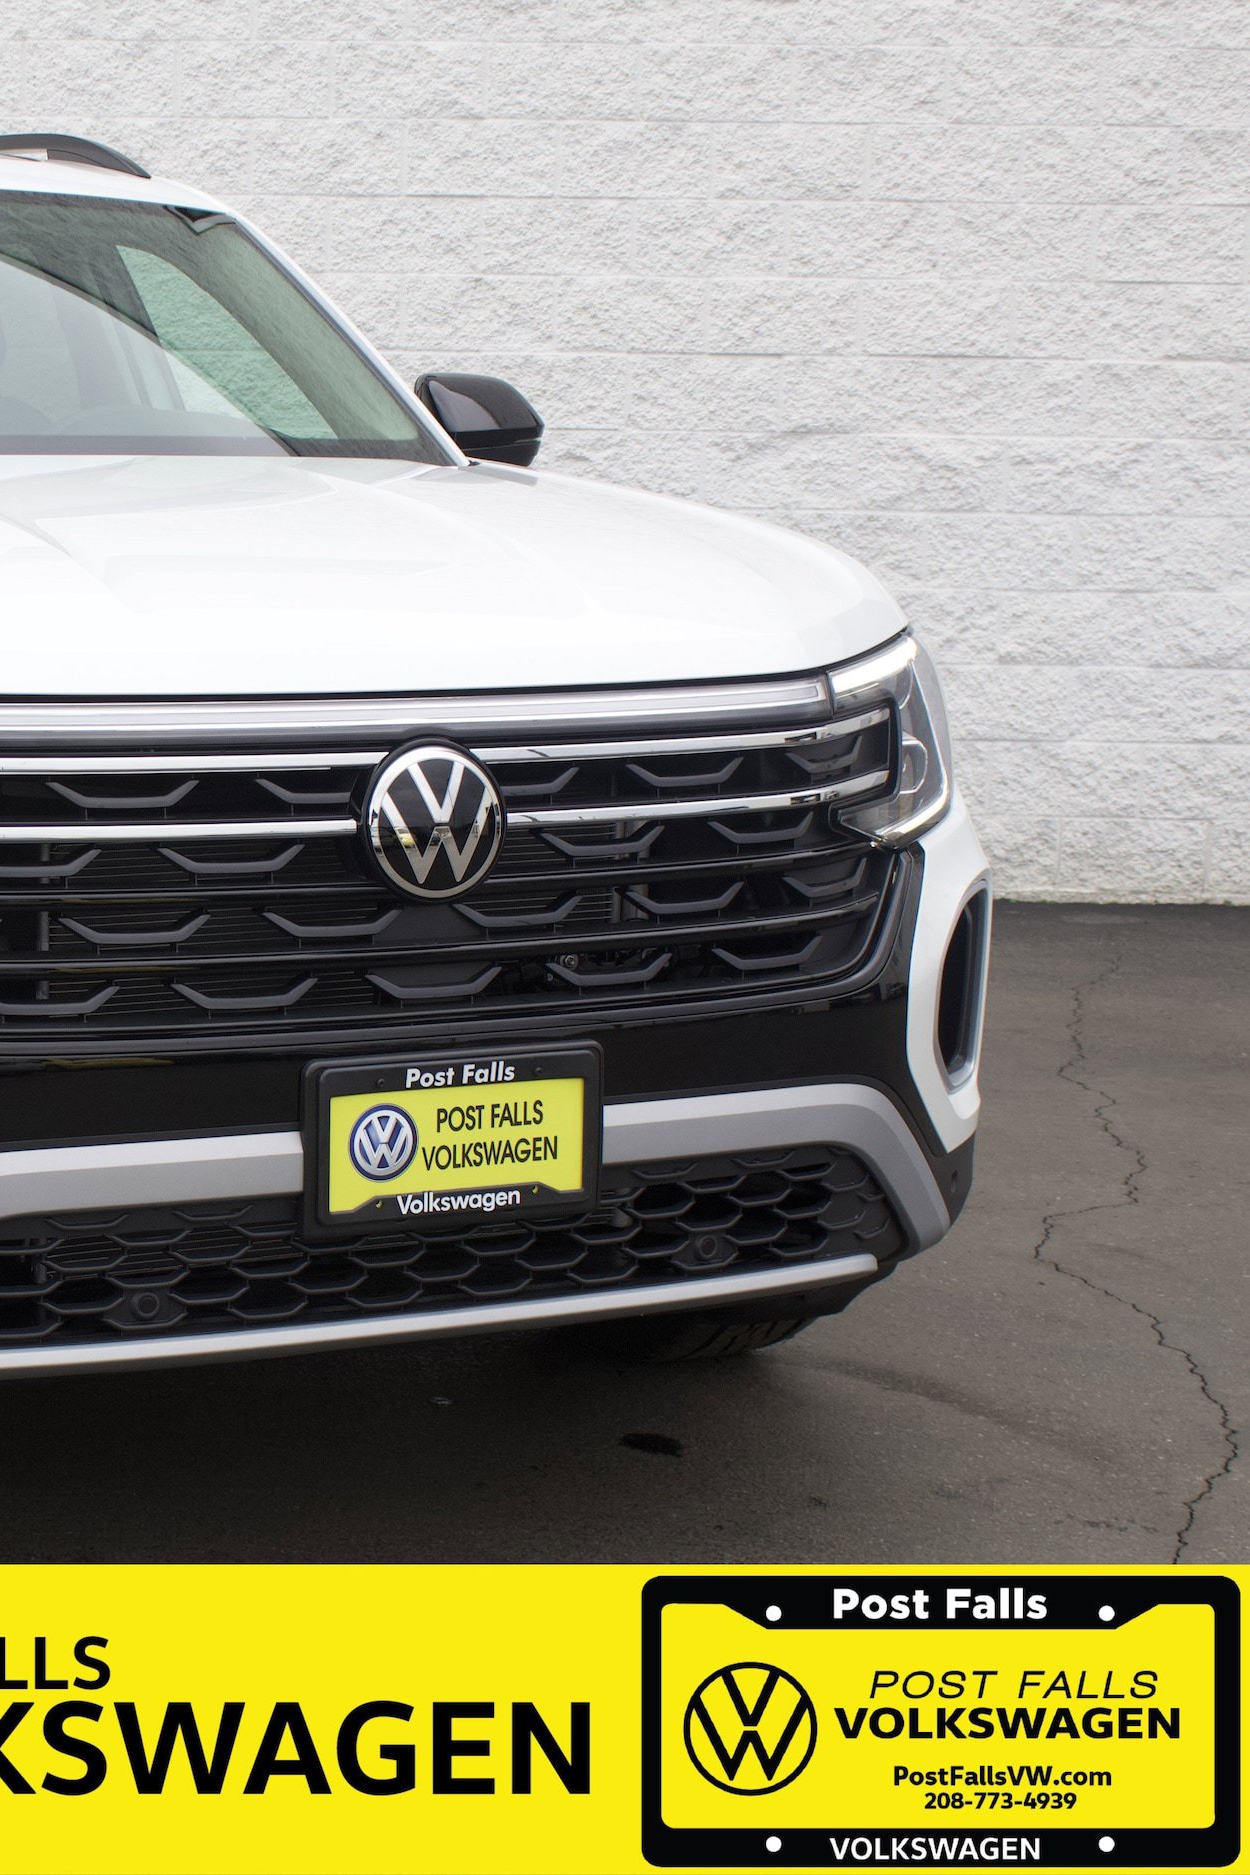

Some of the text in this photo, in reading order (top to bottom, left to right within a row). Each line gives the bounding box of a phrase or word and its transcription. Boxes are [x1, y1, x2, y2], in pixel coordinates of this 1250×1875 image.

[373, 750, 498, 894] VW
[405, 1061, 516, 1089] Post Falls
[436, 1100, 544, 1133] POST FALLS
[352, 1109, 414, 1178] VW
[421, 1136, 559, 1171] VOLKSWAGEN
[396, 1189, 521, 1216] Volkswagen
